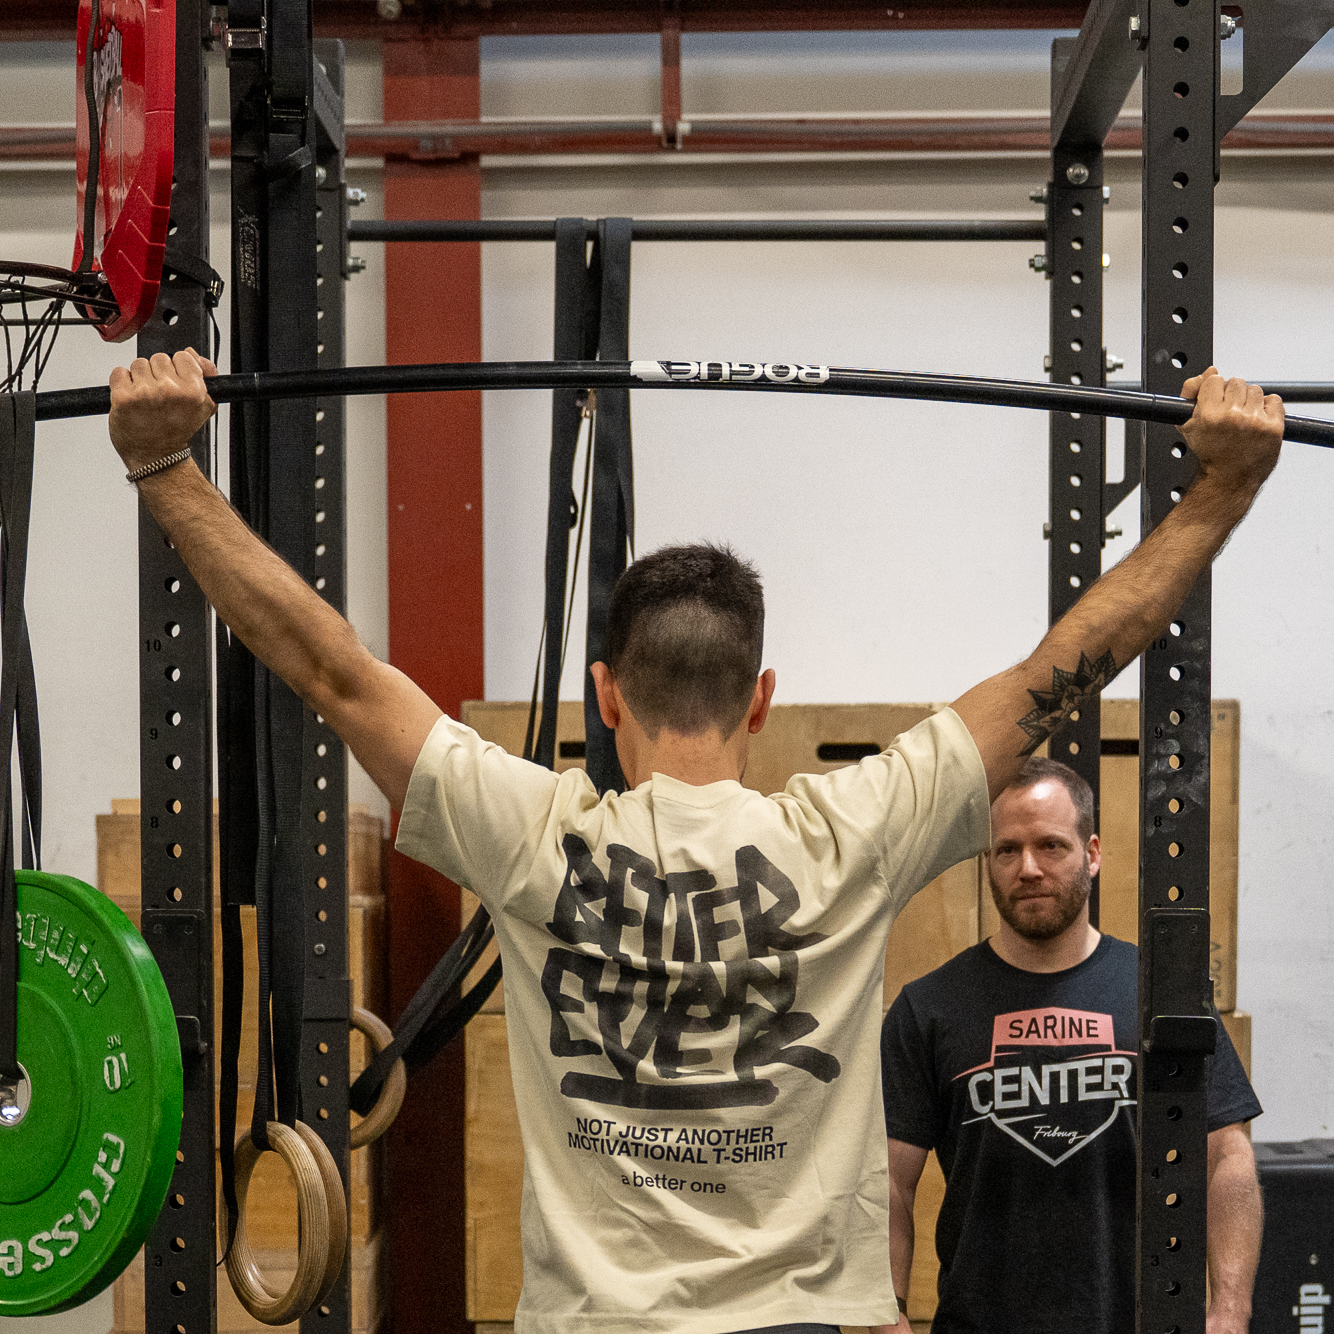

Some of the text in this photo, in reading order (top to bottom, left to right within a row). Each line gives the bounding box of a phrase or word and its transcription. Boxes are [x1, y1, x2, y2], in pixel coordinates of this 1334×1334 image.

[670, 360, 830, 385] ROGUE
[1008, 1015, 1099, 1039] SARINE
[968, 1057, 1132, 1115] CENTER
[576, 1117, 774, 1146] NOT JUST ANOTHER
[1034, 1125, 1090, 1144] Fribourg
[568, 1132, 788, 1165] MOTIVATIONAL T-SHIRT
[621, 1171, 727, 1194] a better one
